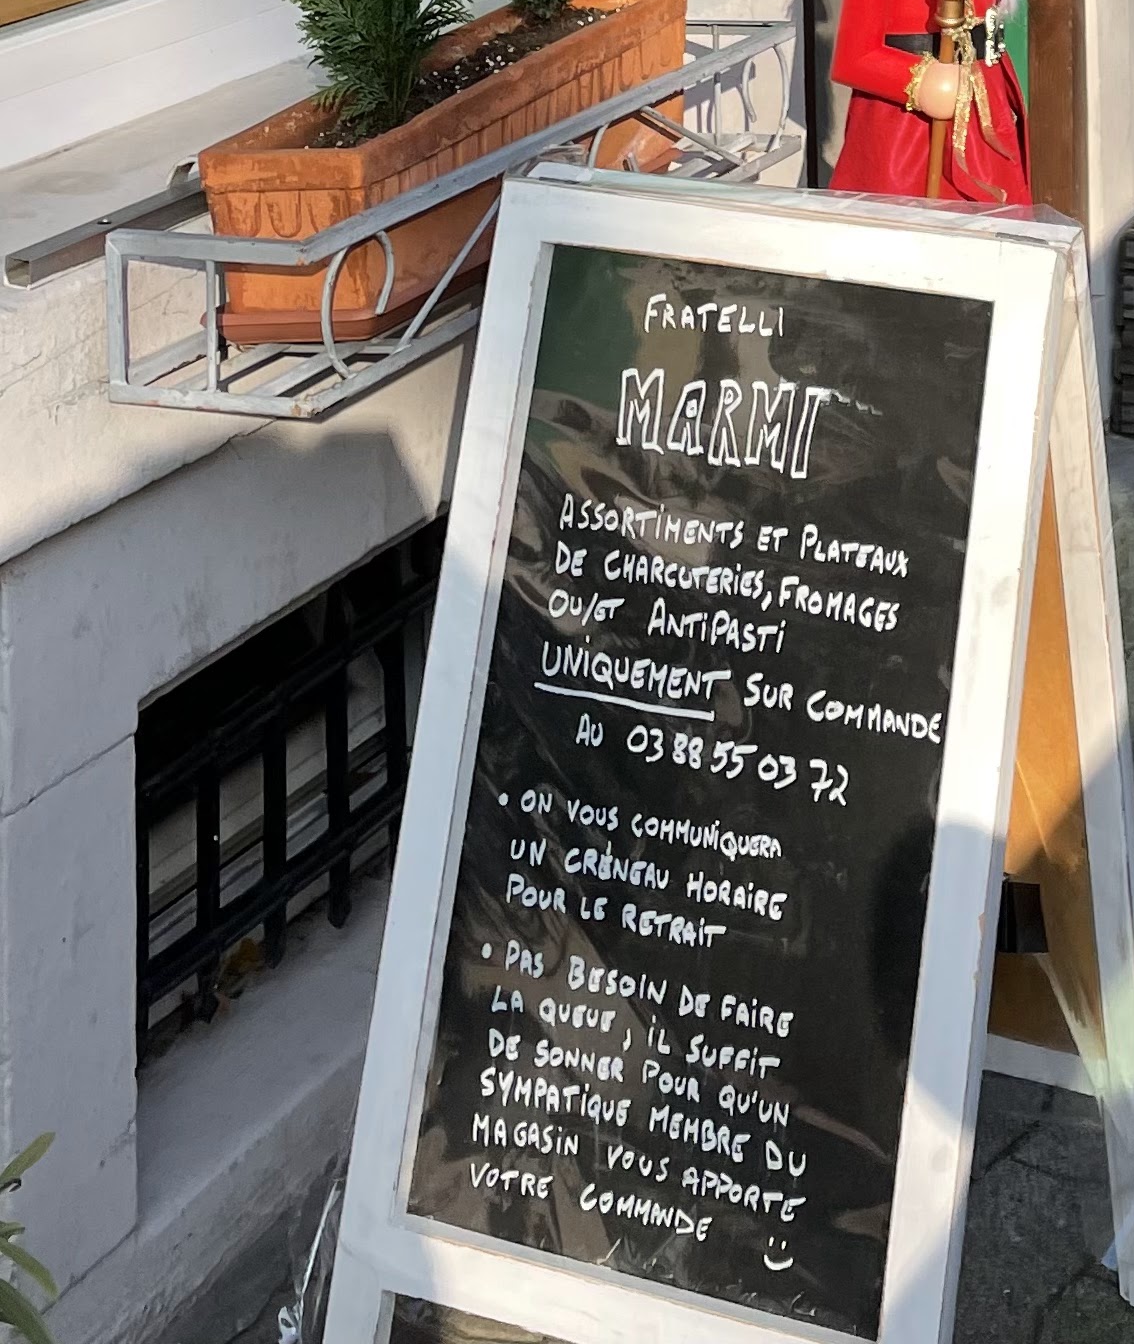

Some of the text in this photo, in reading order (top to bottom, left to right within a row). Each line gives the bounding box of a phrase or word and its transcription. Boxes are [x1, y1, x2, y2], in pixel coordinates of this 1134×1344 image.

[643, 293, 785, 338] FRATELLI
[616, 368, 827, 480] MARMI
[558, 493, 909, 578] ASSORTIMENTS ET PLATEAUX
[548, 589, 788, 655] OU/ET ANTIPASTI
[554, 541, 900, 633] DE CHARCUTERIES, FROMAGES
[541, 635, 942, 744] UNIQUEMENT SUR COMMANDE
[575, 714, 850, 806] AU 03 88 55 03 72
[520, 789, 782, 862] ON VOUS COMMUNIQUERA
[506, 873, 727, 948] POUR LE RETRAIT
[510, 840, 788, 922] UN CRÉNEAU HORAIRE
[491, 985, 524, 1013] LA
[686, 1034, 781, 1080] SUFFIT
[504, 940, 795, 1038] PAS BESOIN DE FAIRE
[480, 1067, 808, 1177] SYMPATIQUE MEMBRE DU
[488, 1028, 790, 1128] DE SONNER POUR QU'UN
[469, 1162, 713, 1242] VOTRE COMMANDE
[472, 1113, 808, 1223] MAGASIN VOUS APPORTE
